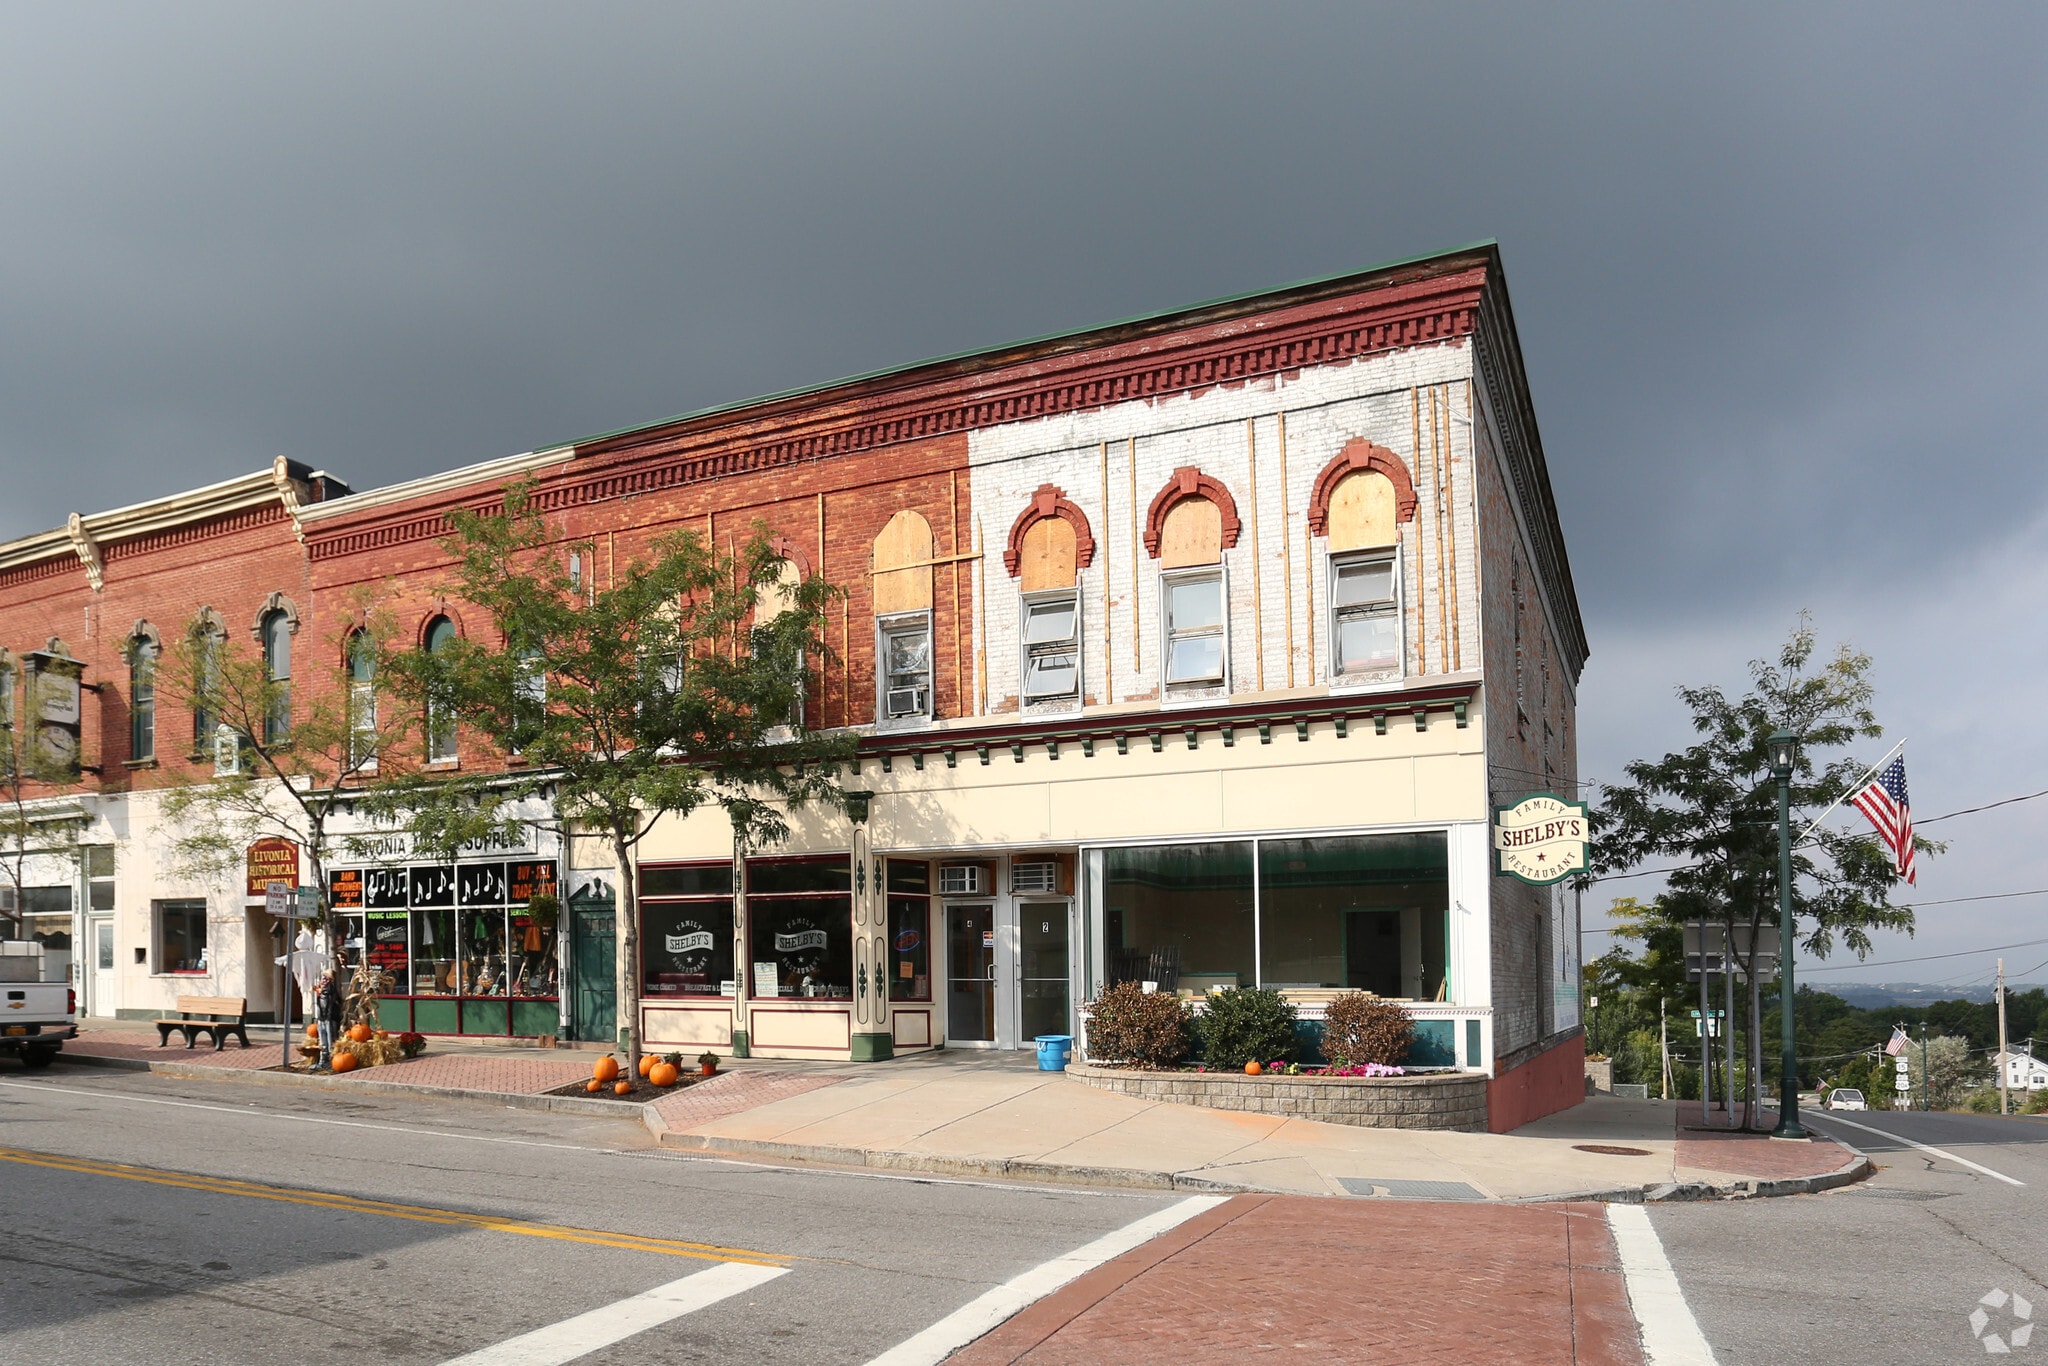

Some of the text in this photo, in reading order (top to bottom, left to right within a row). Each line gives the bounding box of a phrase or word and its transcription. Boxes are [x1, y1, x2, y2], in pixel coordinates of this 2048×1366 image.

[1516, 800, 1565, 817] FAMILY
[1502, 819, 1580, 847] SHELBY'S
[254, 849, 291, 862] LIVONIA
[356, 837, 406, 858] IVONIA
[249, 863, 296, 876] HISTORICAL
[1508, 851, 1576, 878] RESTAURANT
[512, 884, 533, 899] TRADE
[676, 920, 703, 931] FAMILY
[786, 918, 815, 929] FAMILY
[1043, 922, 1049, 932] 2
[670, 934, 709, 950] SHELBY'S
[779, 933, 823, 949] SHELBY'S
[672, 956, 708, 974] RESTAURANT
[782, 956, 820, 974] RESTAURANT
[684, 983, 711, 992] BREAKFAST
